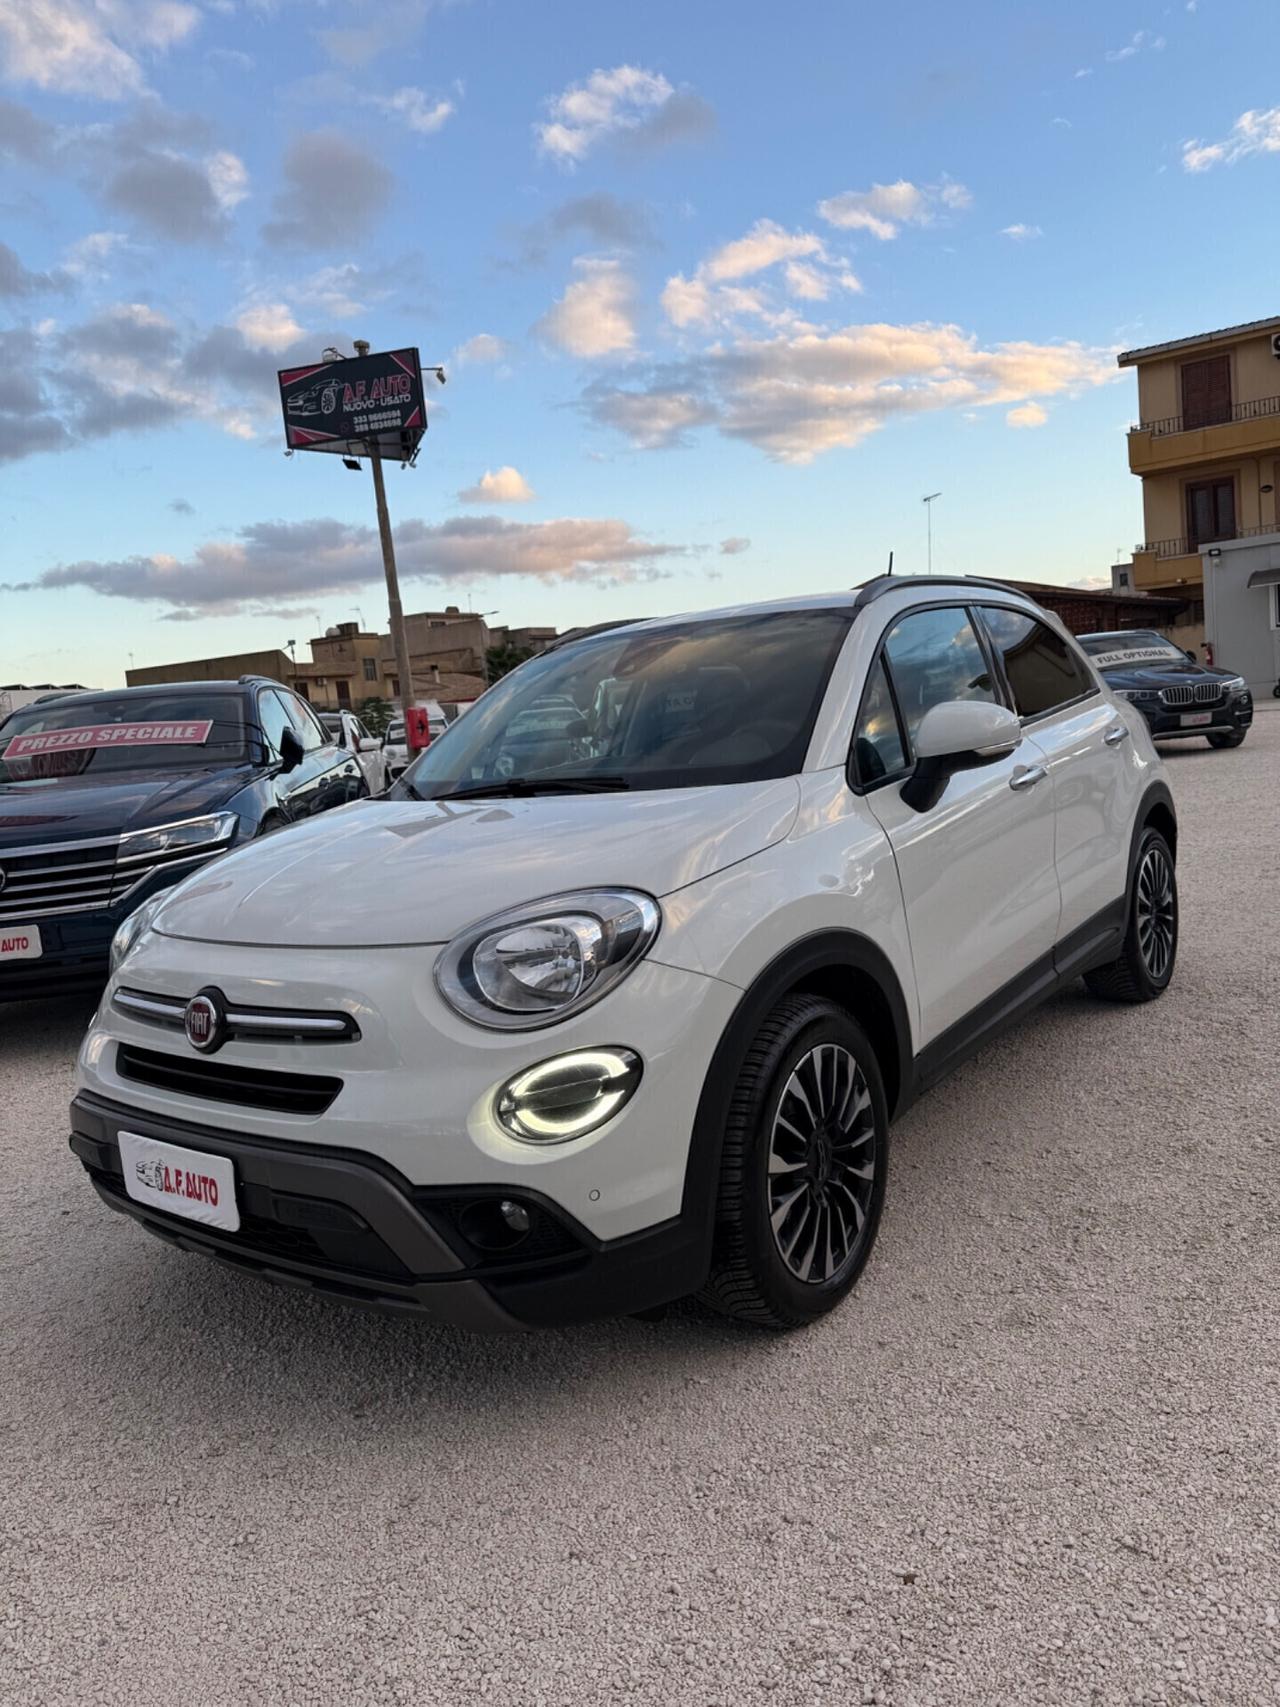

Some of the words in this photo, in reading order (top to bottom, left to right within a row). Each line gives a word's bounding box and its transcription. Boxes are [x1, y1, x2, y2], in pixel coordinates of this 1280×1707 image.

[370, 373, 411, 399] AUTO
[343, 399, 375, 412] NUOVO
[380, 393, 411, 406] USATO
[1096, 653, 1122, 664] FULL
[1123, 648, 1171, 660] OPTIONAL
[17, 731, 93, 751] PREZZO
[96, 726, 198, 742] SPECIALE
[1, 936, 29, 953] AUTO
[191, 1011, 209, 1035] FIAT
